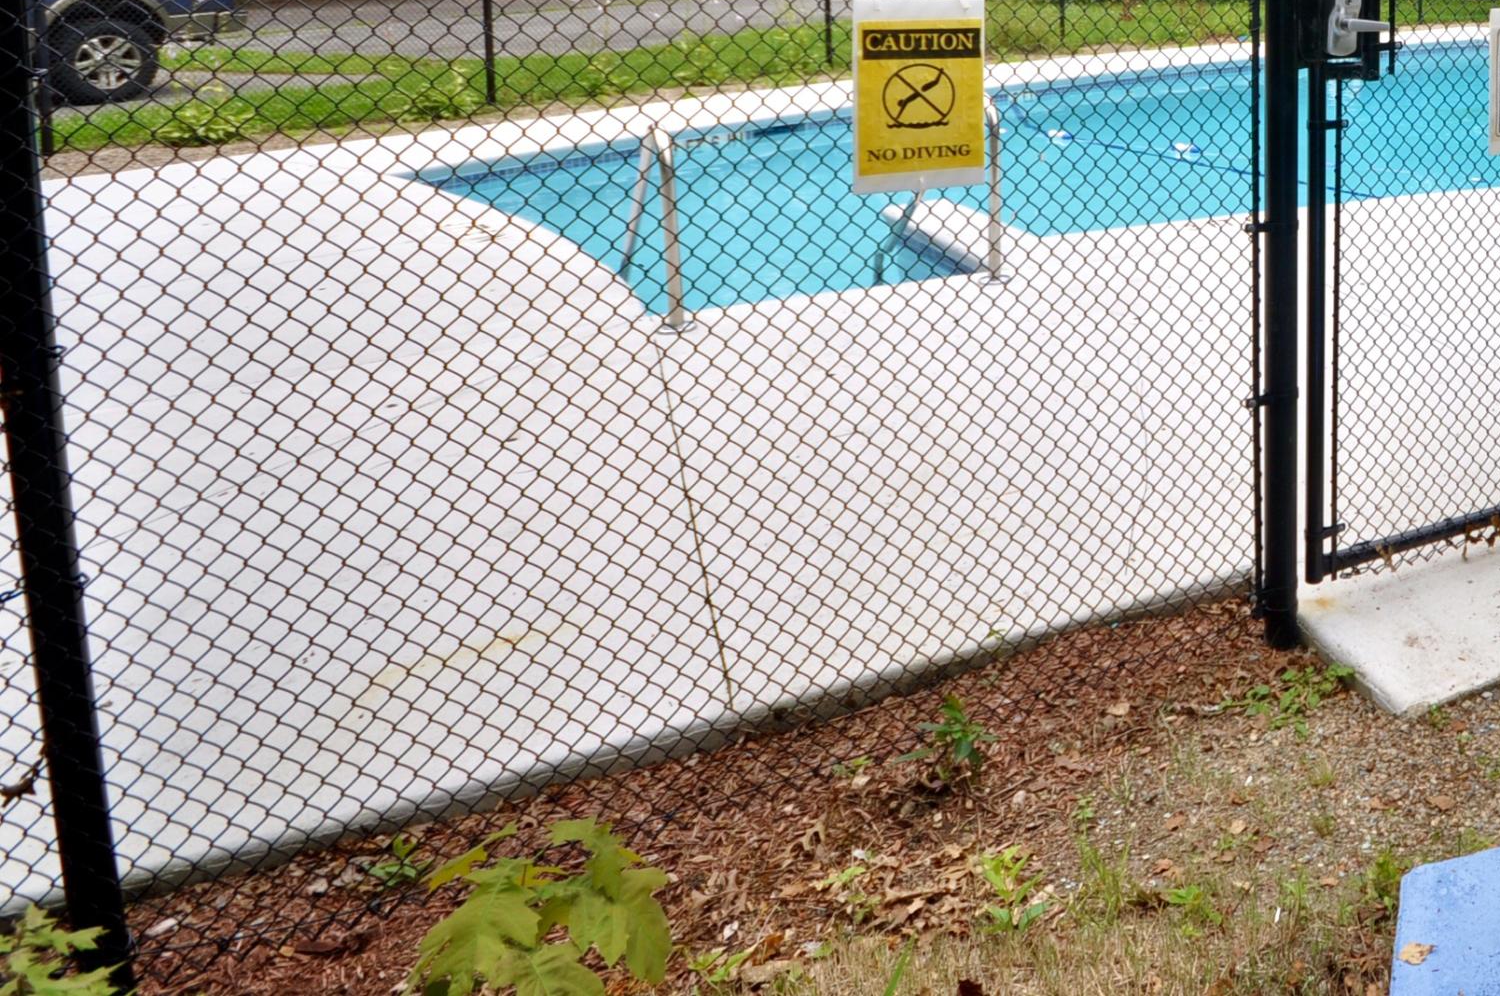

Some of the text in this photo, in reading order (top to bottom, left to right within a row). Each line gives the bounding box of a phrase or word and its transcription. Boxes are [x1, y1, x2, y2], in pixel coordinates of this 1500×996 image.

[865, 32, 975, 52] CAUTION
[867, 144, 971, 162] NO DIVING
